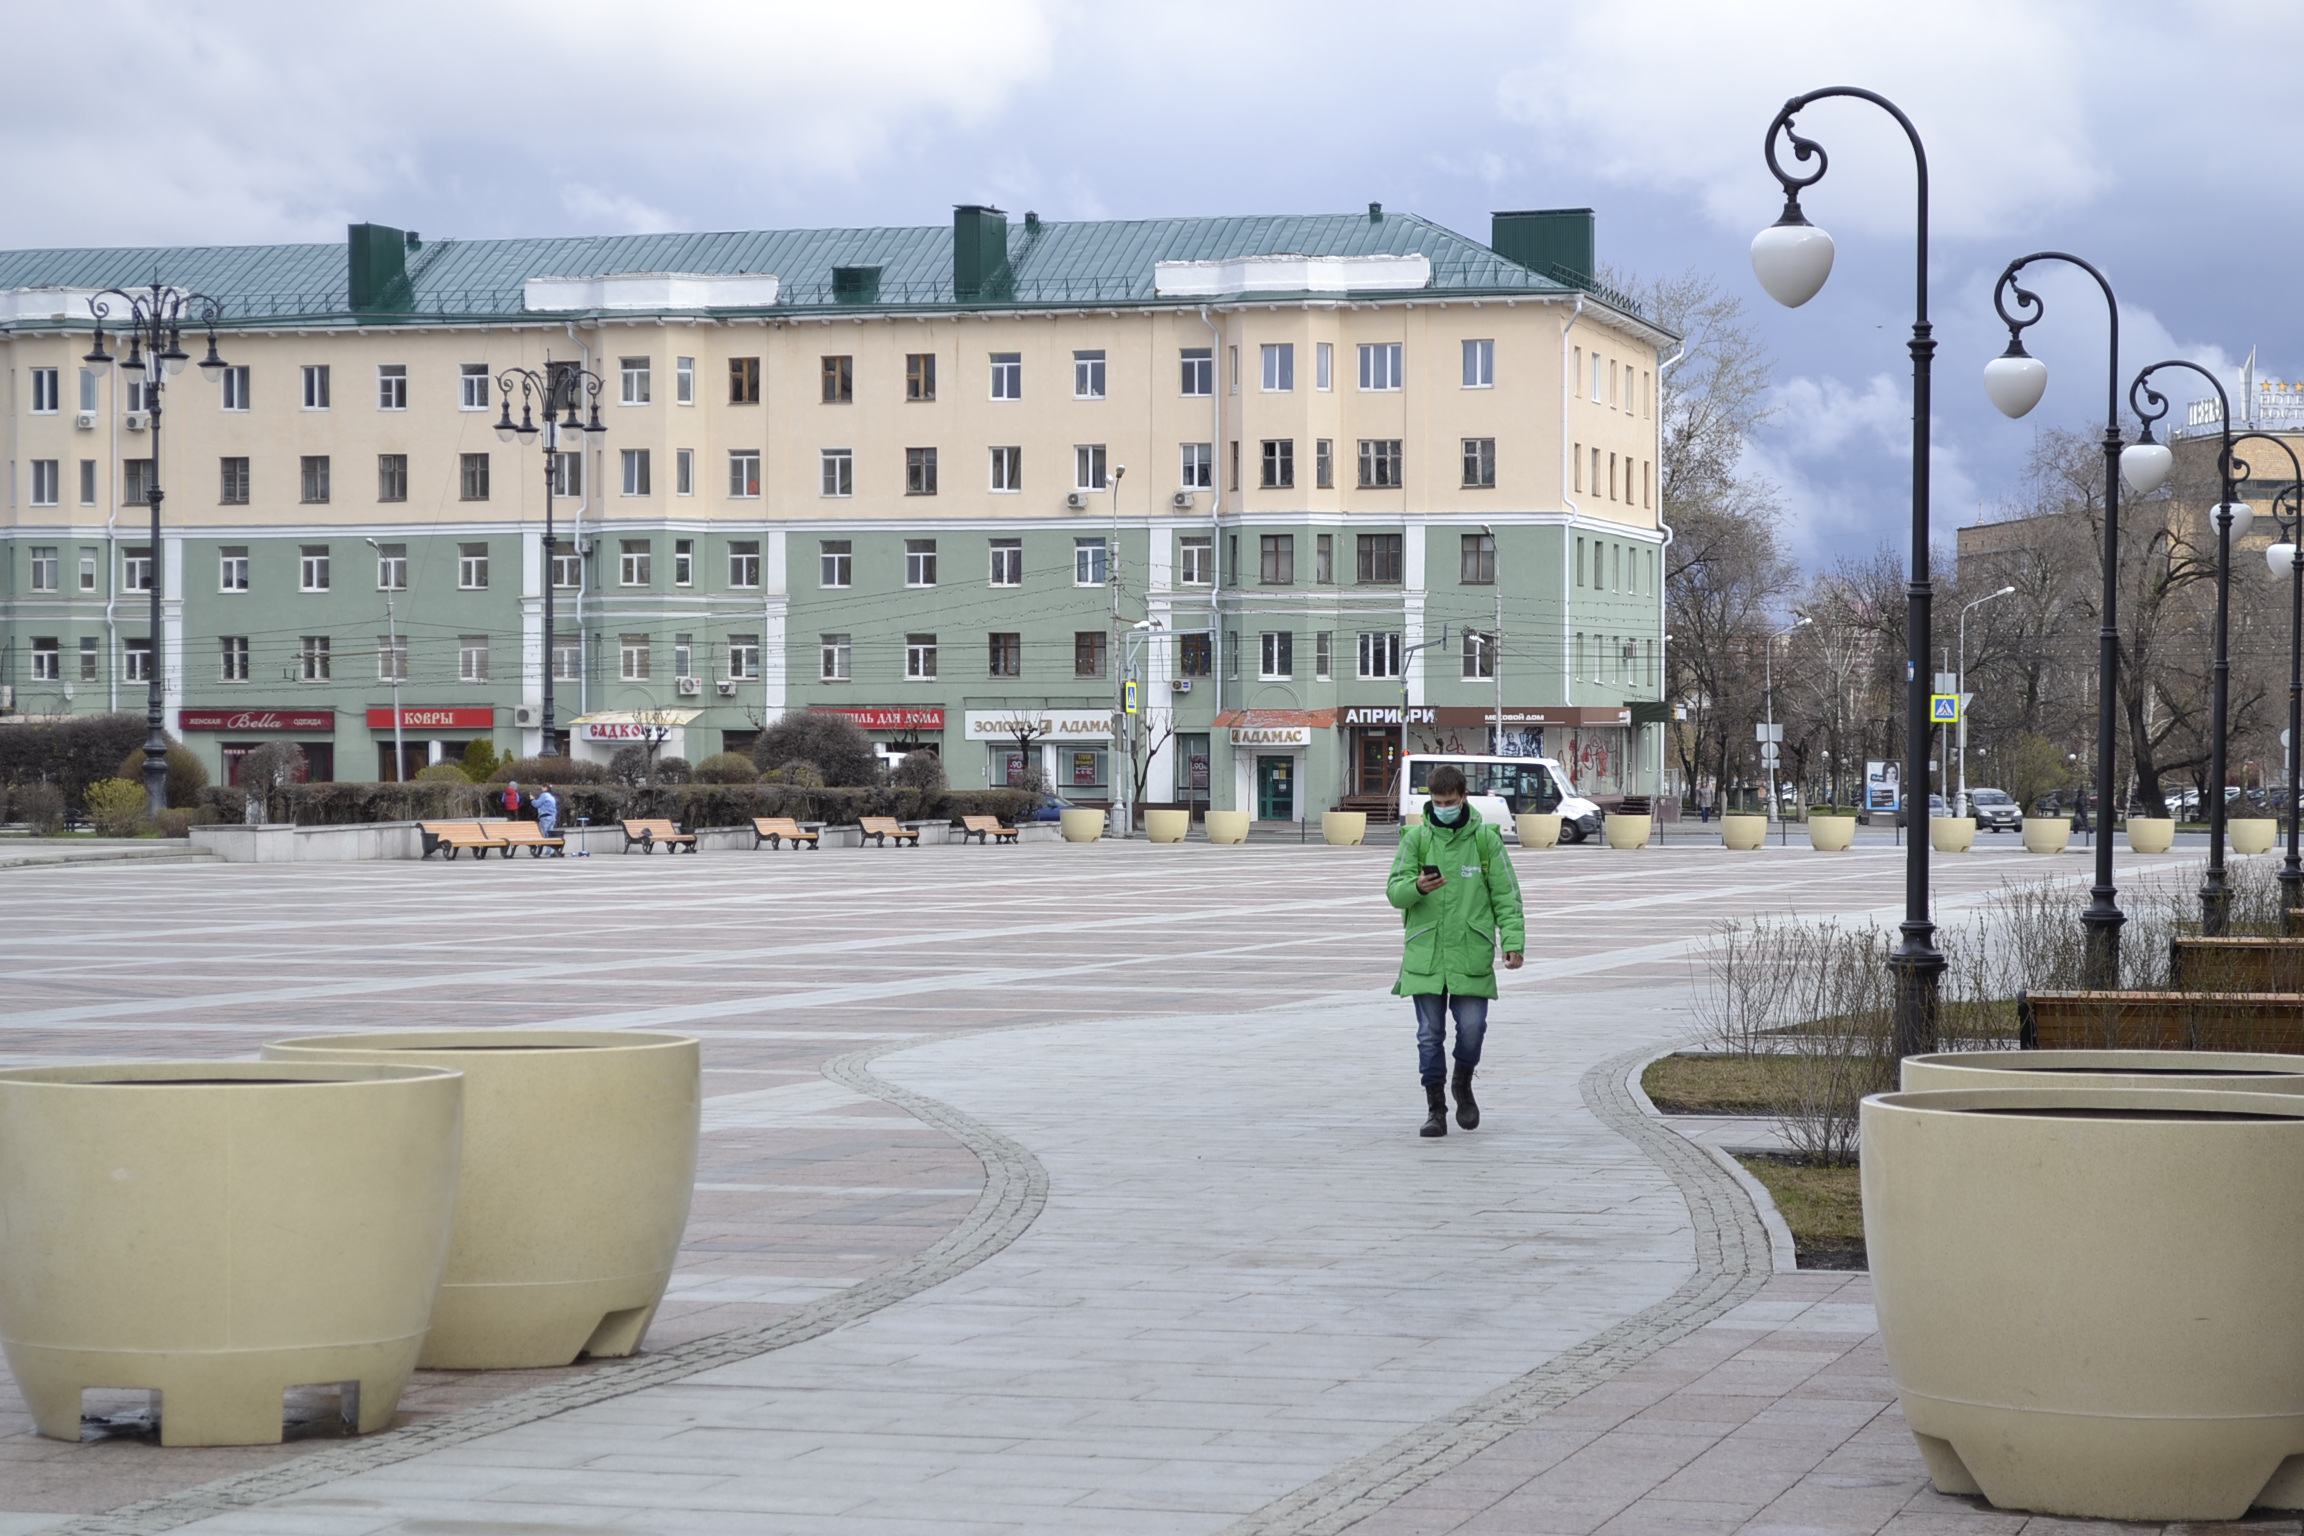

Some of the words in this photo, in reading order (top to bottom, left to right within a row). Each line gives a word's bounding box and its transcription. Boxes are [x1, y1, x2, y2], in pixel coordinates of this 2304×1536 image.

[2259, 407, 2304, 419] ГОСТ
[227, 711, 283, 729] Bella
[293, 718, 322, 726] ОДЕЖДА
[404, 712, 454, 725] КОВРЫ
[877, 712, 901, 726] ДЛЯ
[1484, 713, 1525, 721] МЕОВОЙ
[589, 724, 642, 739] САДКО
[1241, 730, 1303, 743] АДАМАС
